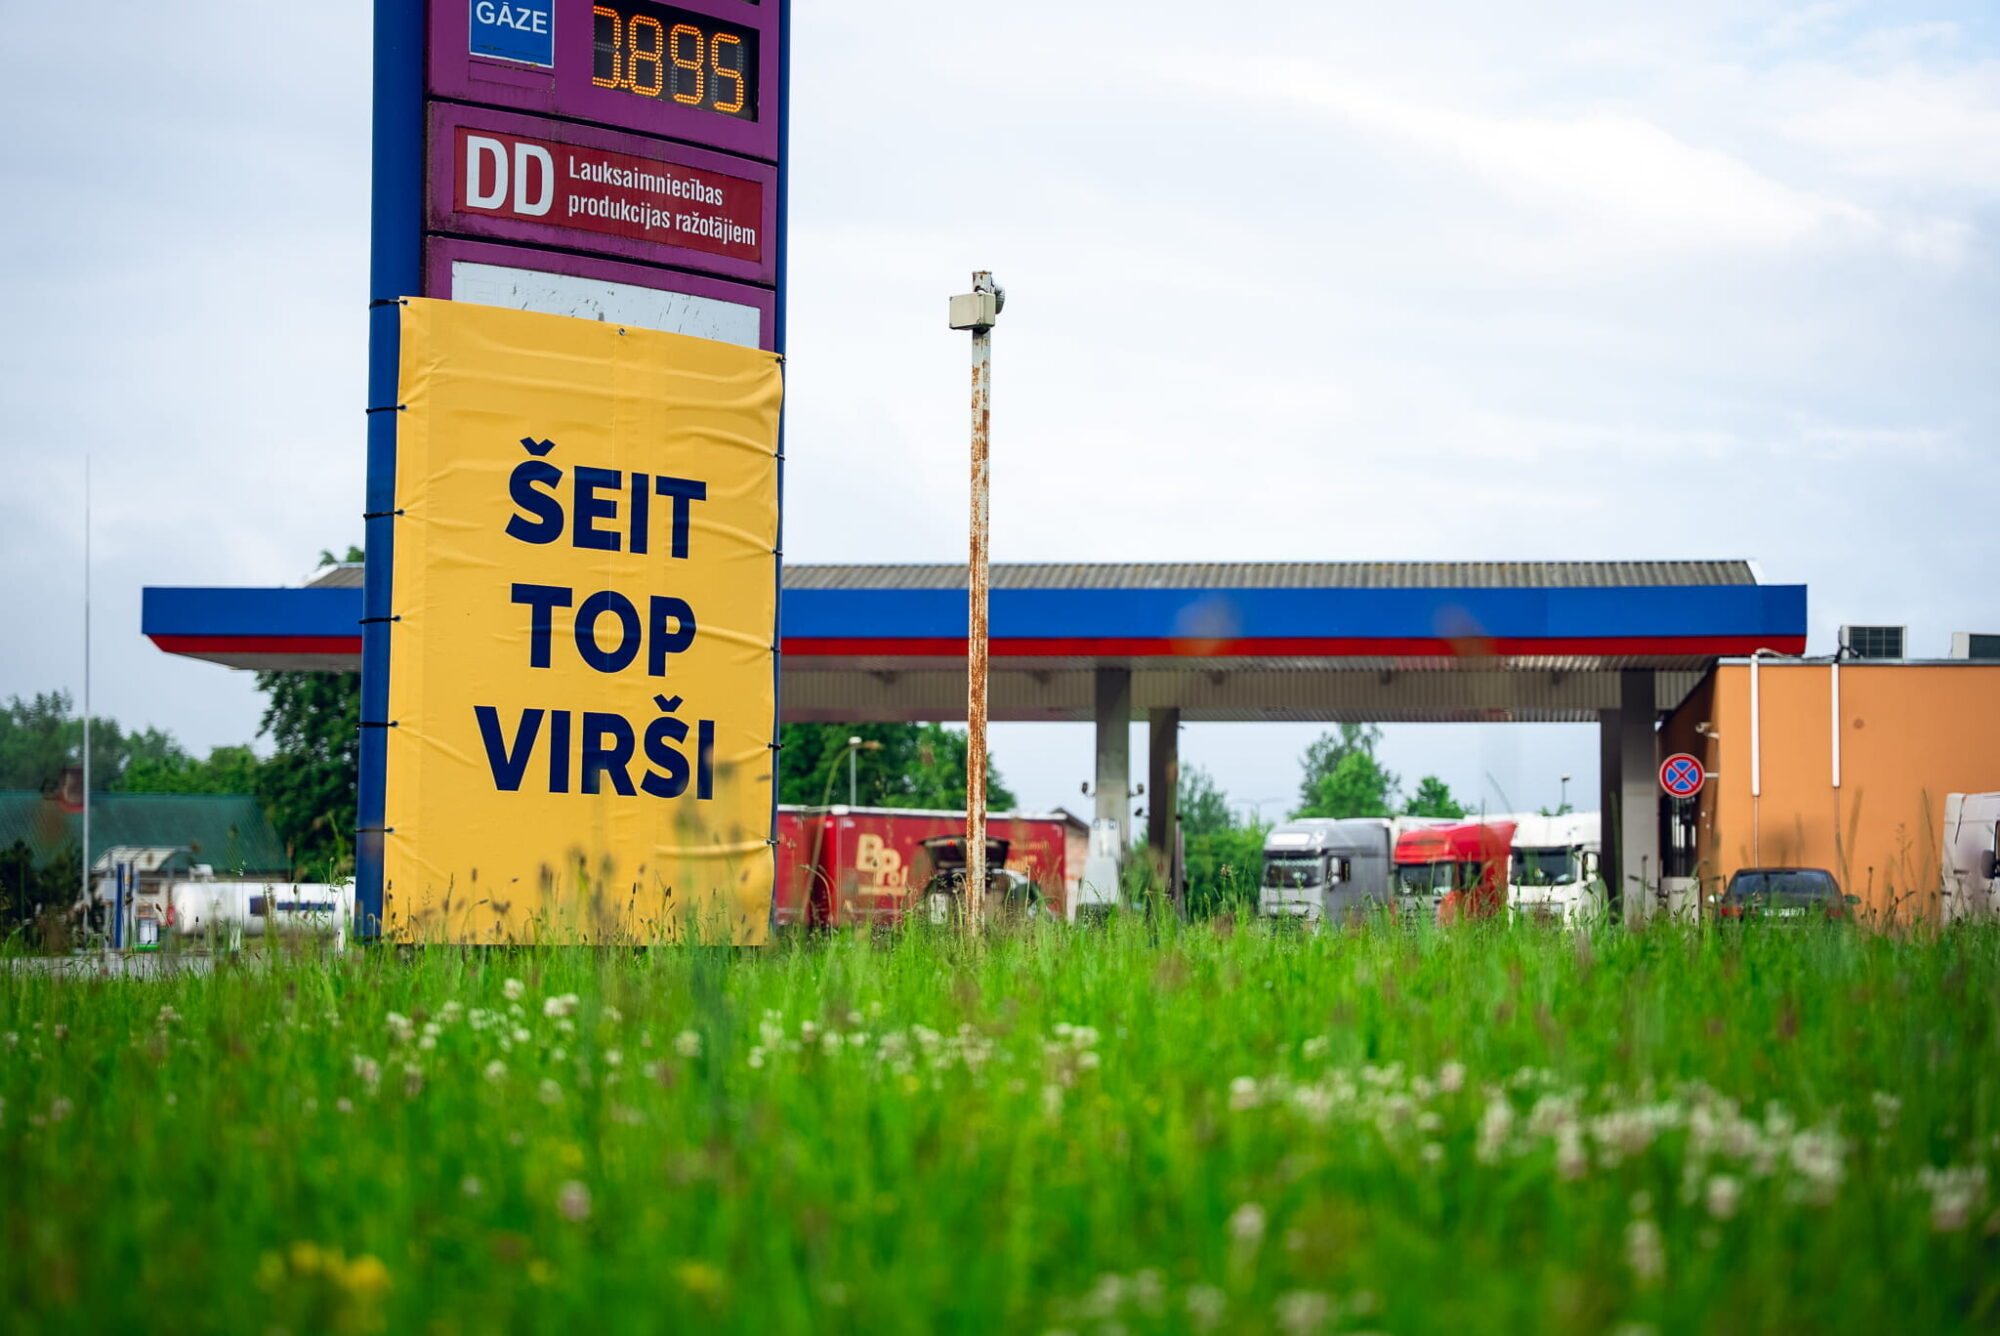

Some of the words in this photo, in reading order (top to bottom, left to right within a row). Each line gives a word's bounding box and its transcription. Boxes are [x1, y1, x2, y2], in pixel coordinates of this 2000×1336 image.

[476, 1, 548, 34] GĀZE
[465, 134, 555, 217] DD
[569, 155, 723, 206] Lauksaimniecības
[568, 195, 670, 230] produkcijas
[676, 211, 756, 246] ražotājiem
[505, 437, 706, 559] ŠEIT
[511, 583, 697, 677] TOP
[474, 694, 715, 800] VIRŠI
